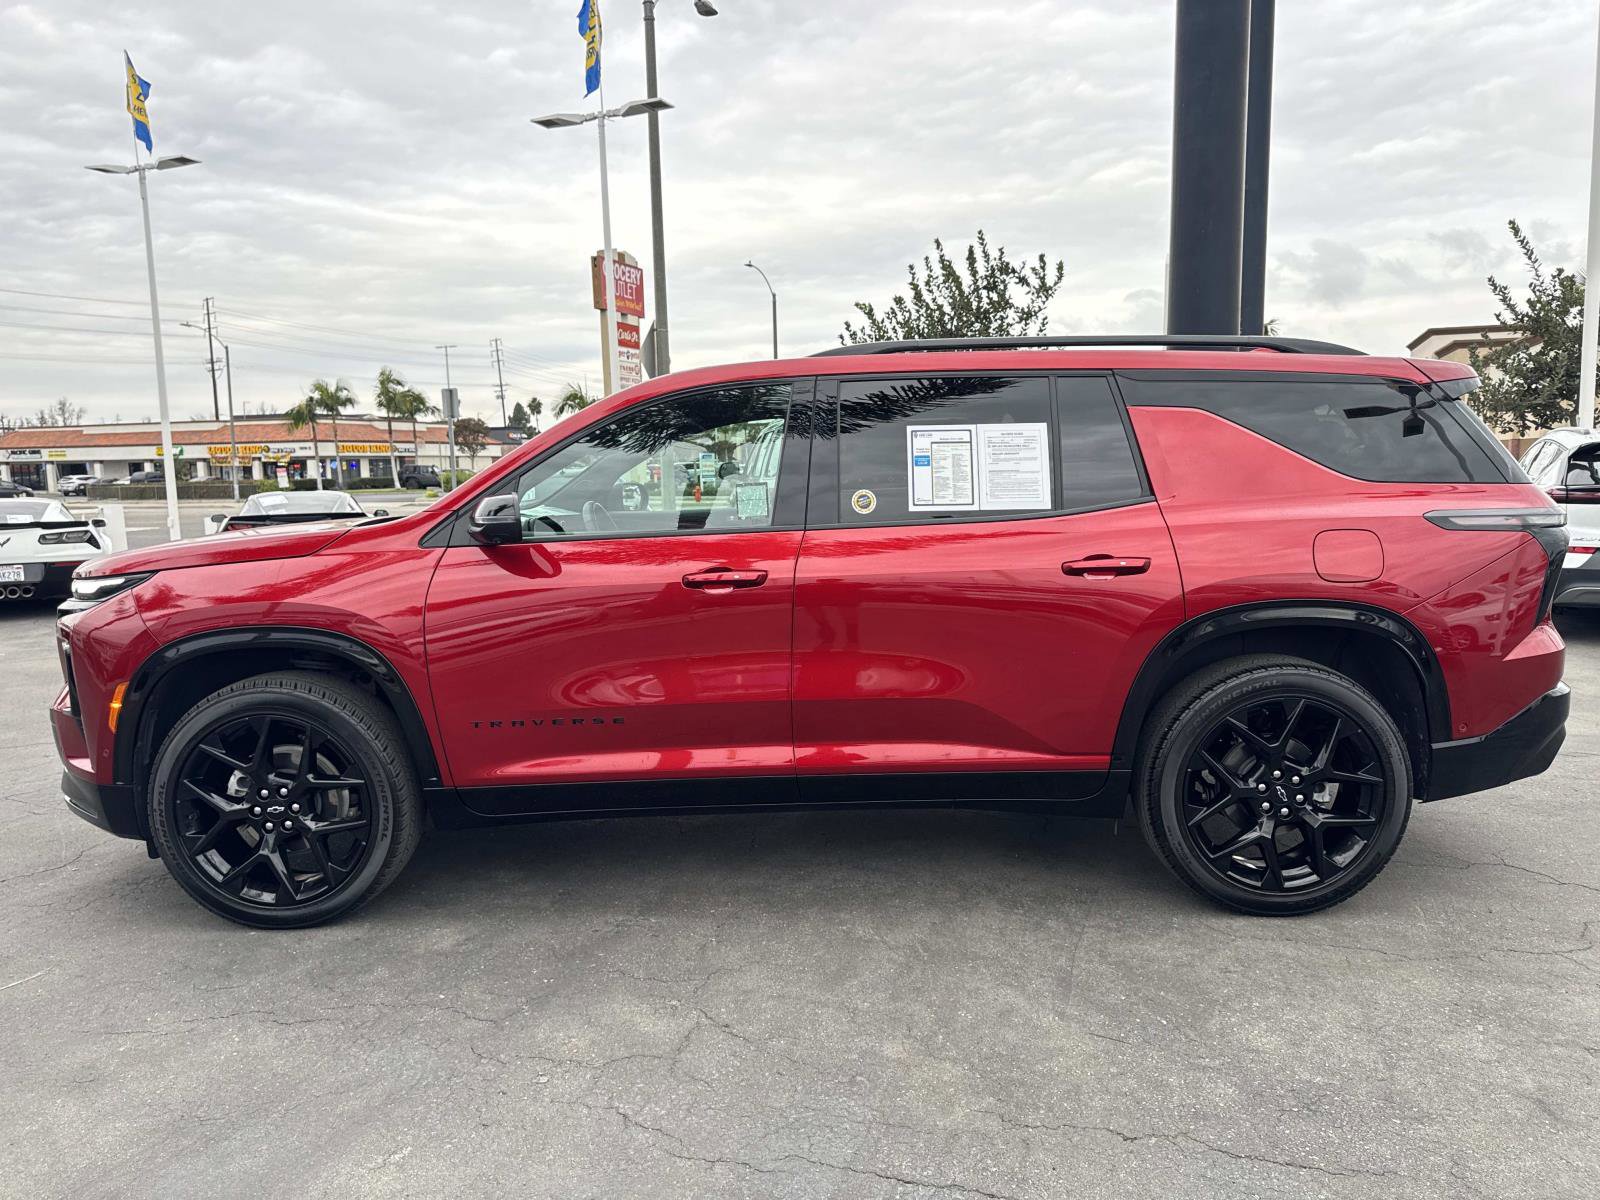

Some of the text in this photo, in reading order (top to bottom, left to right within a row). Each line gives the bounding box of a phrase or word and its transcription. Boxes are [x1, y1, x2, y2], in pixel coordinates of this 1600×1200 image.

[602, 260, 641, 285] OCERY
[613, 280, 637, 299] UTLET
[470, 717, 625, 728] TRAVERSE
